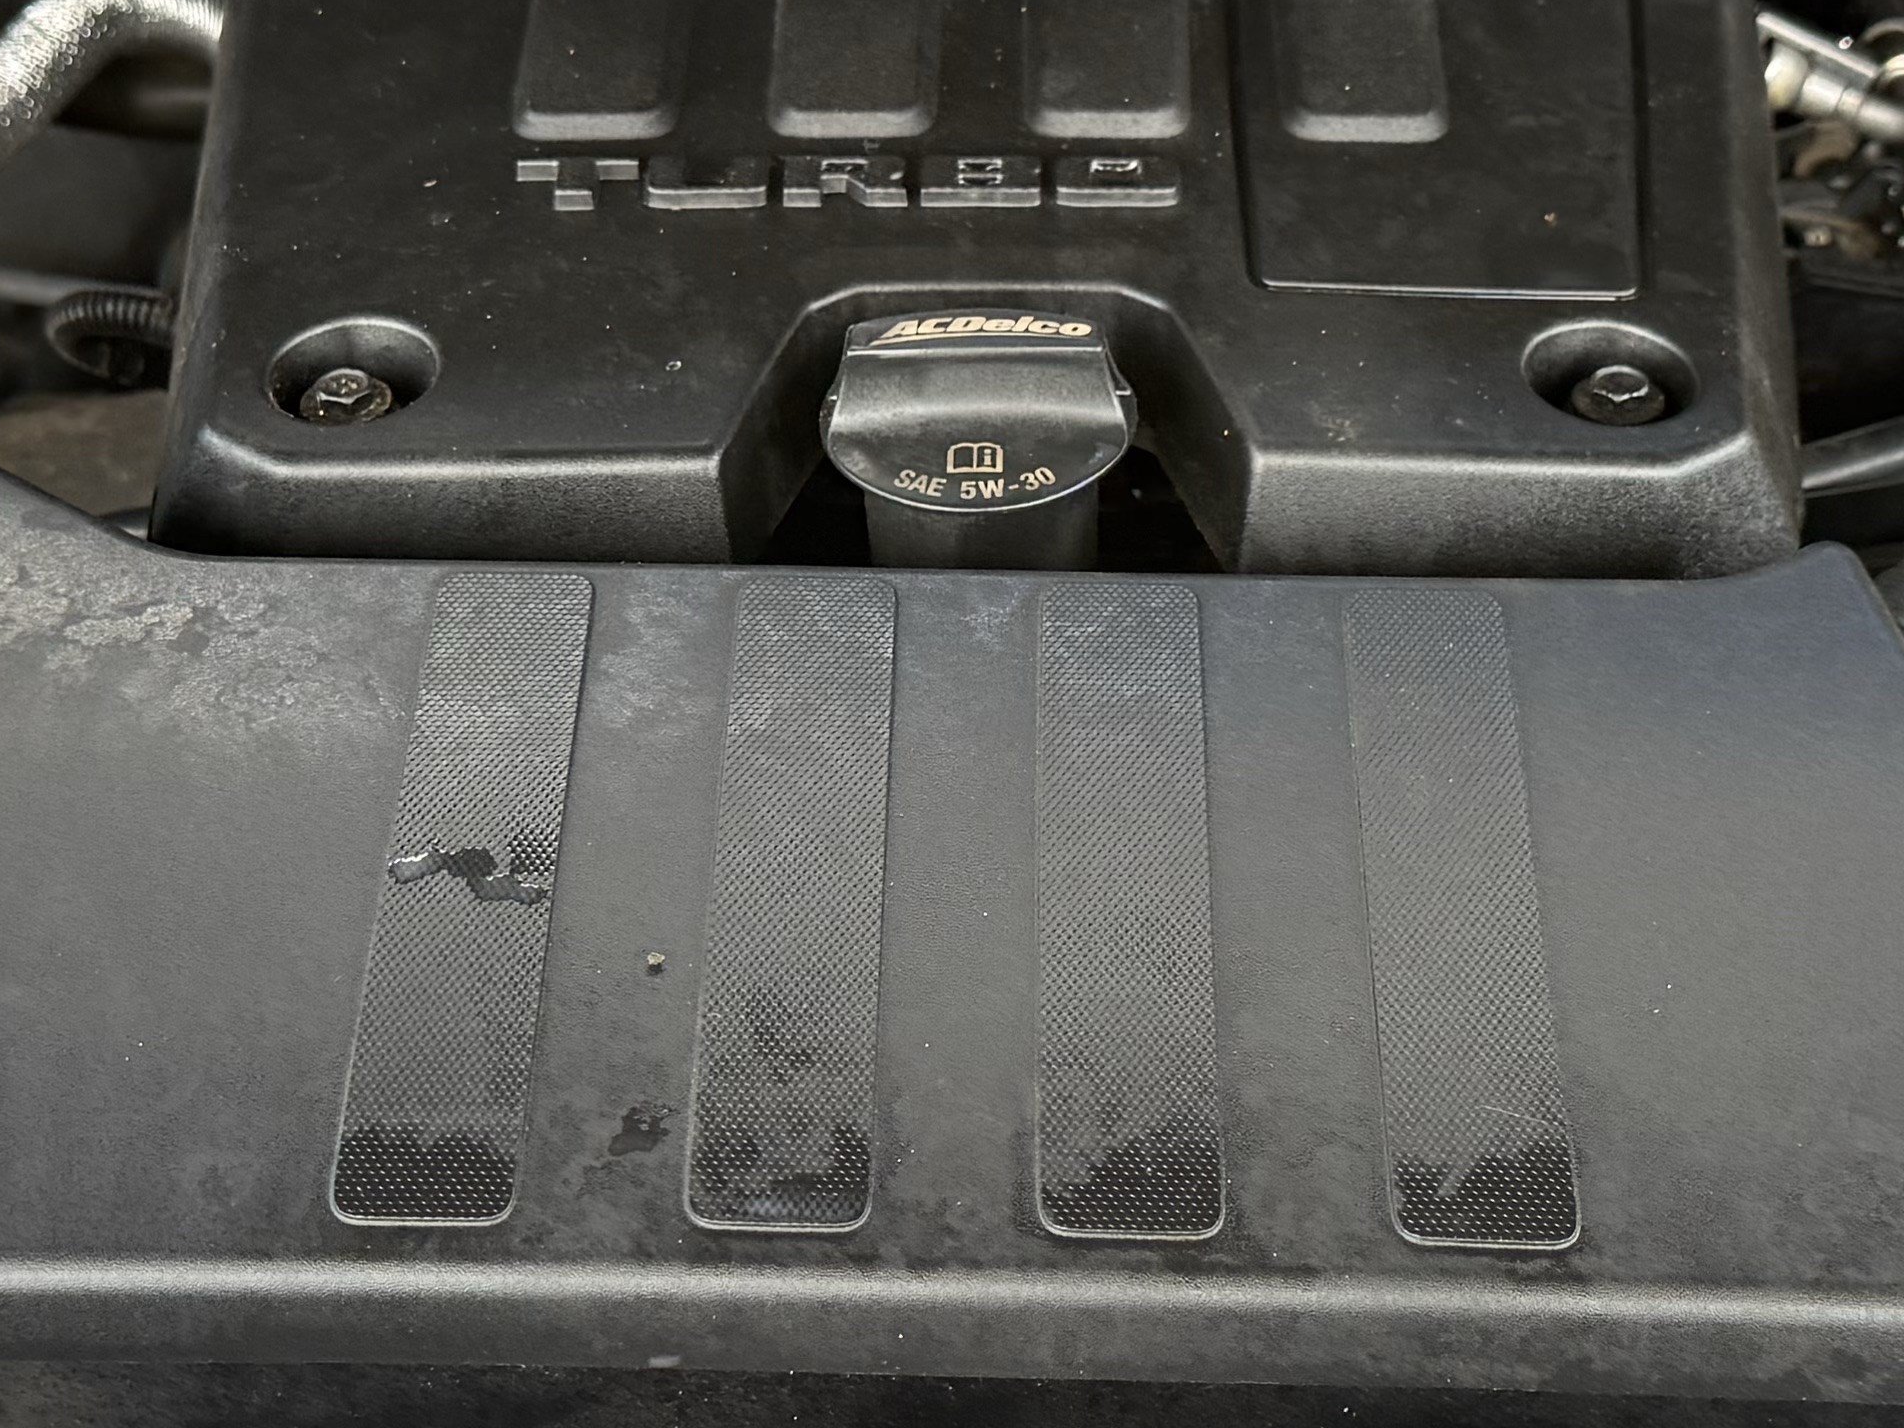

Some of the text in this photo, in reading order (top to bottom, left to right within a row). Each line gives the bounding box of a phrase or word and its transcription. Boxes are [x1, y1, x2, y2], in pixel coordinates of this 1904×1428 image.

[516, 155, 1179, 210] TURBO
[880, 316, 1093, 339] ACDelco
[893, 466, 1056, 500] SAE 5W-30
